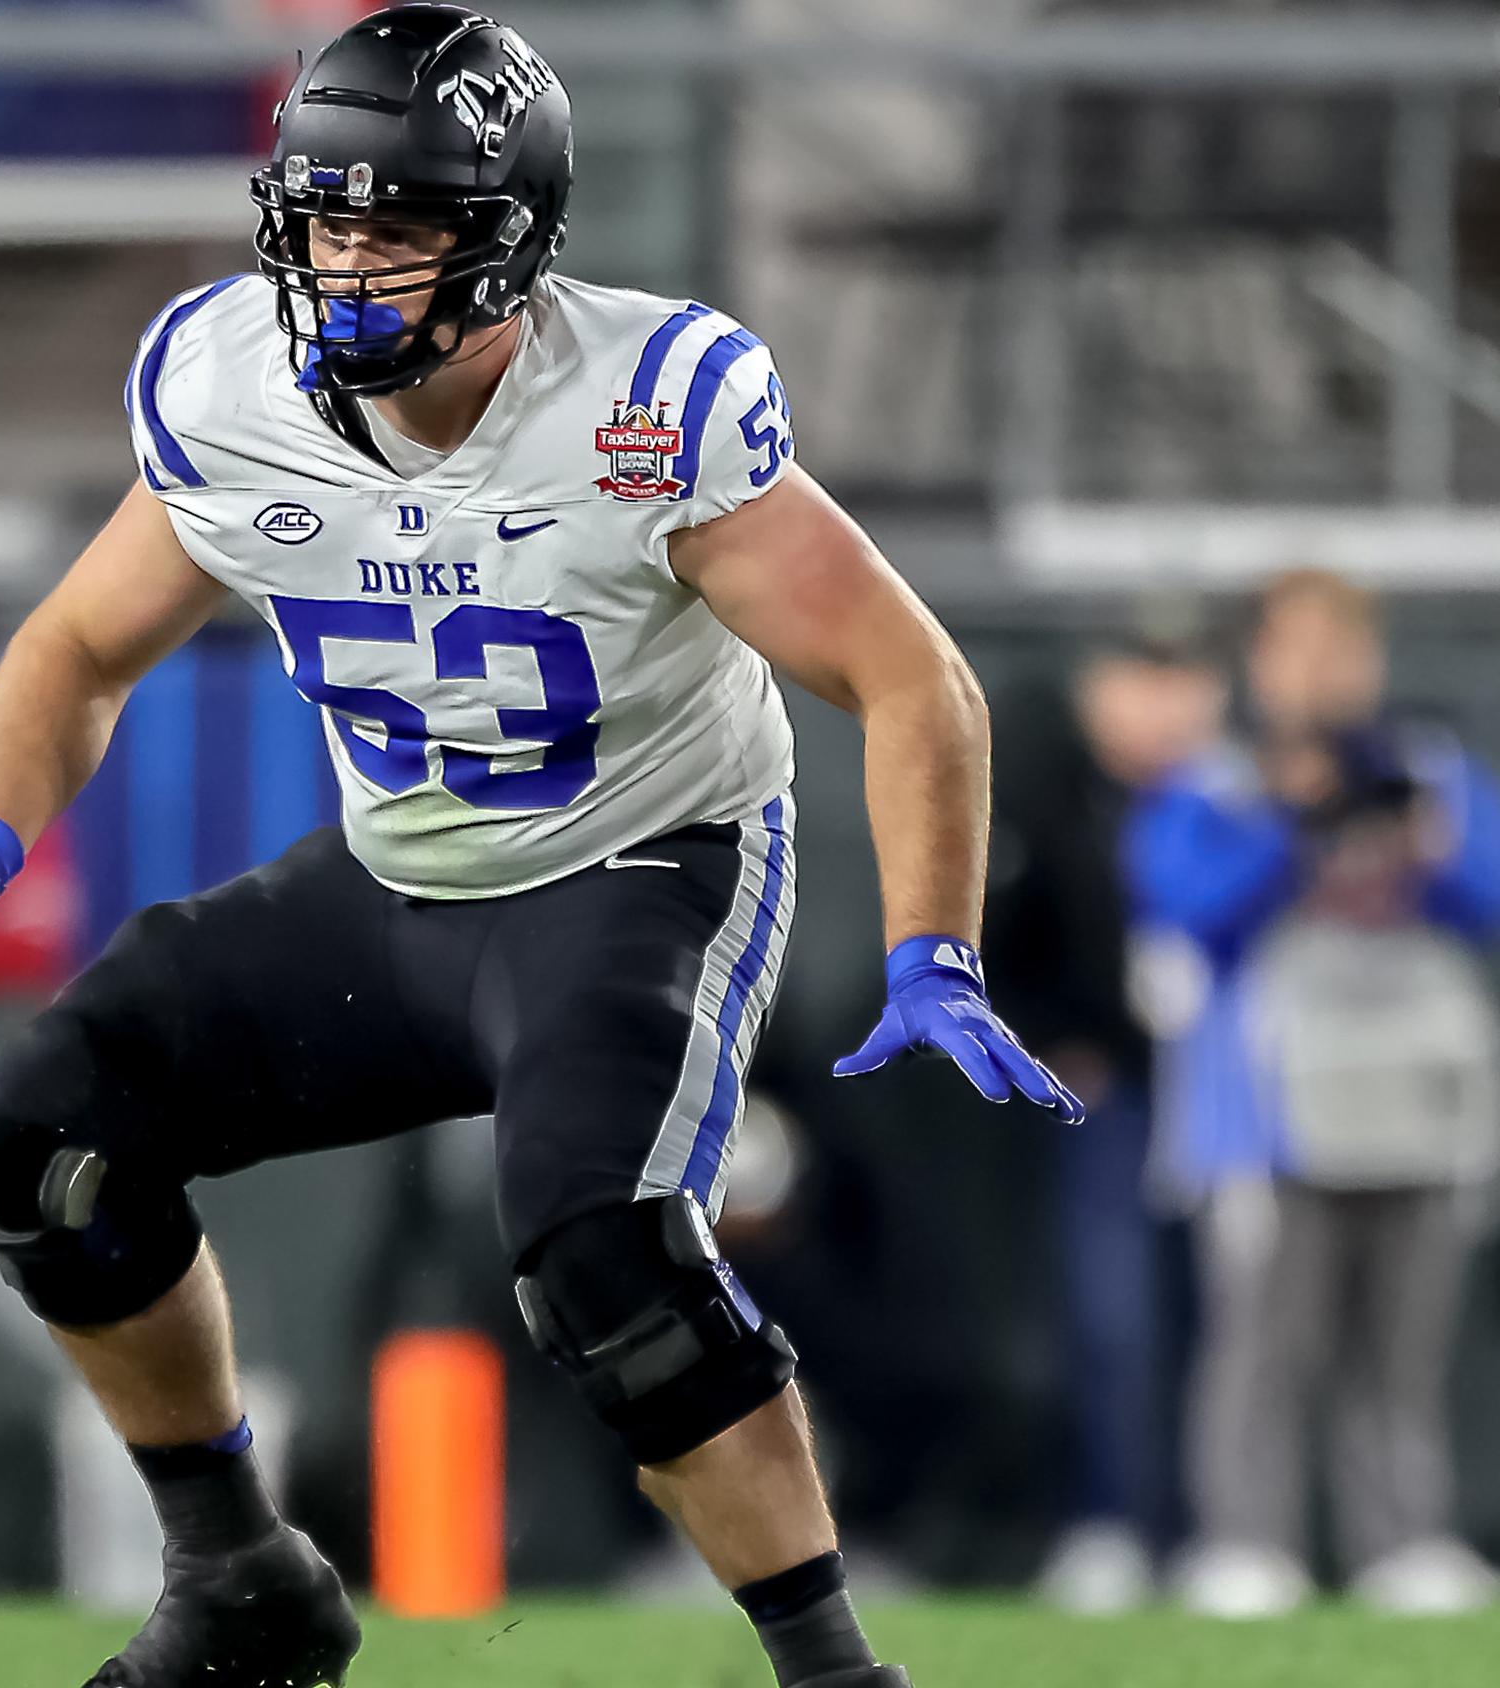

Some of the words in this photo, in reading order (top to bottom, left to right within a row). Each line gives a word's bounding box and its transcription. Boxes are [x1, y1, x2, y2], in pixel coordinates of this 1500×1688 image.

[600, 431, 676, 450] TaxSlayer
[263, 512, 312, 529] ACC
[396, 505, 424, 531] D
[356, 558, 481, 596] DUKE
[266, 594, 602, 810] 53
